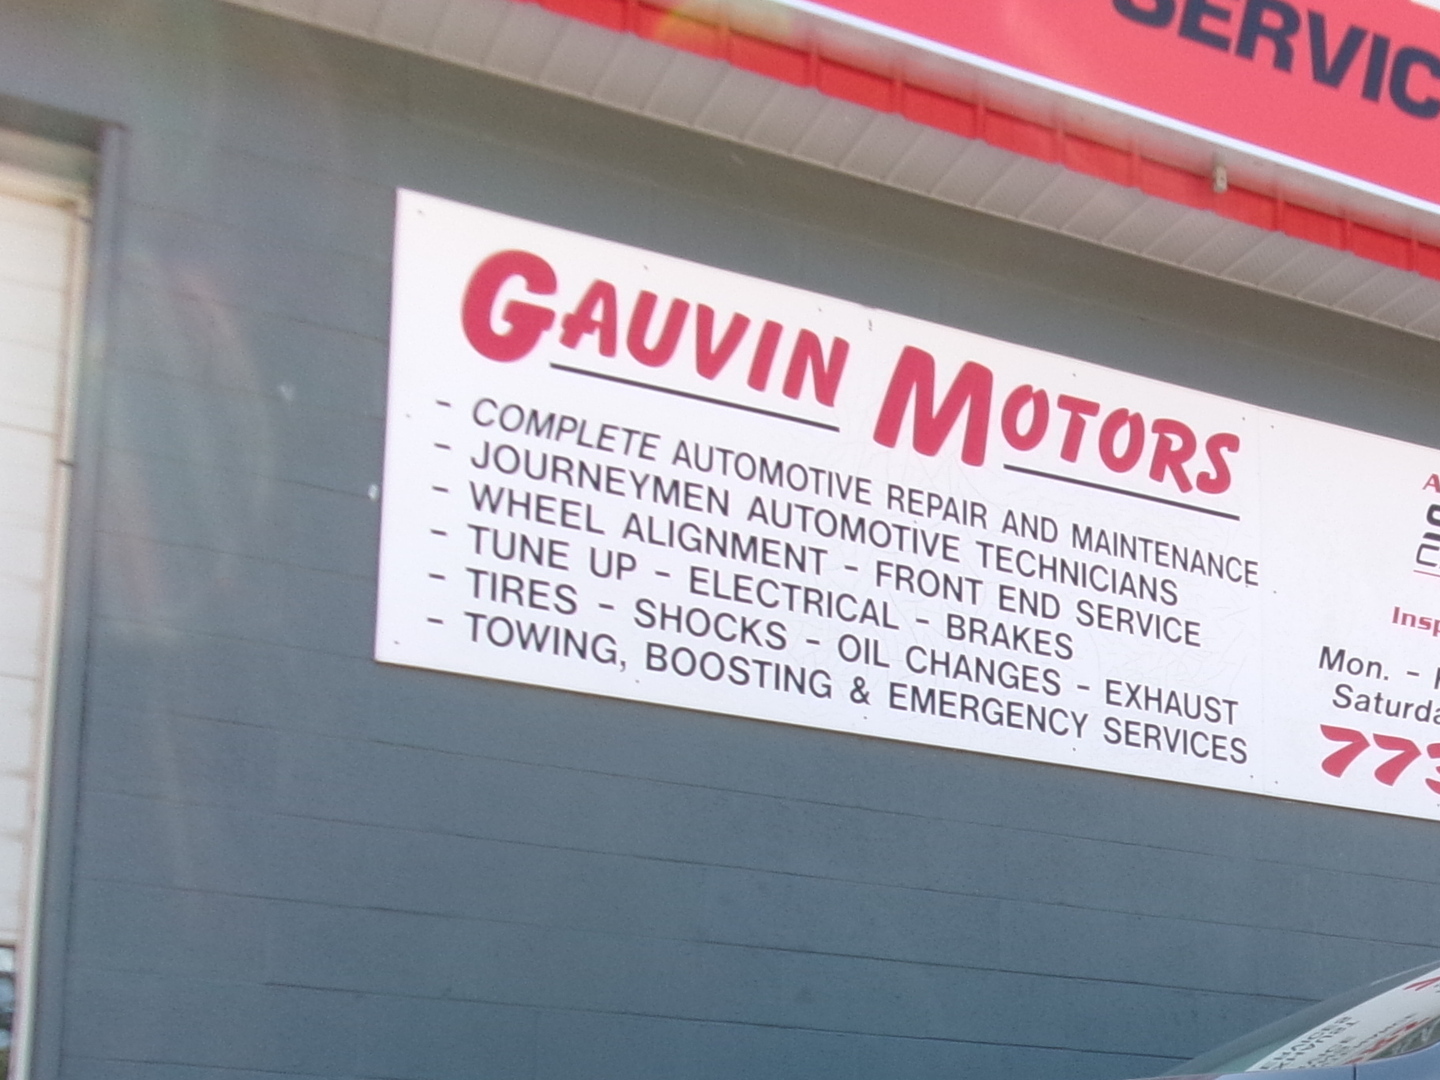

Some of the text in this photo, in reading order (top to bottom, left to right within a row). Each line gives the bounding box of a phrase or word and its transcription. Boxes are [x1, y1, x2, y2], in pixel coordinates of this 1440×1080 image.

[462, 251, 1240, 494] GAUVIN MOTORS
[470, 481, 605, 535] WHEEL
[622, 513, 828, 575] ALIGNMENT
[876, 560, 983, 605] FRONT
[999, 584, 1060, 619] END
[1076, 600, 1201, 647] SERVICE
[471, 441, 729, 516] JOURNEYMEN
[747, 496, 960, 563] AUTOMOTIVE
[976, 541, 1177, 606] TECHNICIANS
[473, 398, 661, 461] COMPLETE
[672, 440, 871, 505] AUTOMOTIVE
[888, 484, 987, 529] REPAIR
[1002, 509, 1058, 543] AND
[1072, 523, 1258, 586] MAINTENANCE
[466, 567, 577, 615] TIRES
[634, 598, 786, 650] SHOCKS
[838, 634, 890, 668] OIL
[906, 646, 1060, 696] CHANGES
[1106, 679, 1238, 725] EXHAUST
[468, 524, 569, 570] TUNE
[590, 547, 637, 580] UP
[690, 566, 899, 630] ELECTRICAL
[947, 613, 1073, 660] BRAKES
[1319, 646, 1388, 680] Mon.
[464, 612, 625, 671] TOWING,
[646, 642, 831, 698] BOOSTING
[850, 676, 869, 705] &
[890, 682, 1088, 738] EMERGENCY
[1104, 717, 1247, 764] SERVICES
